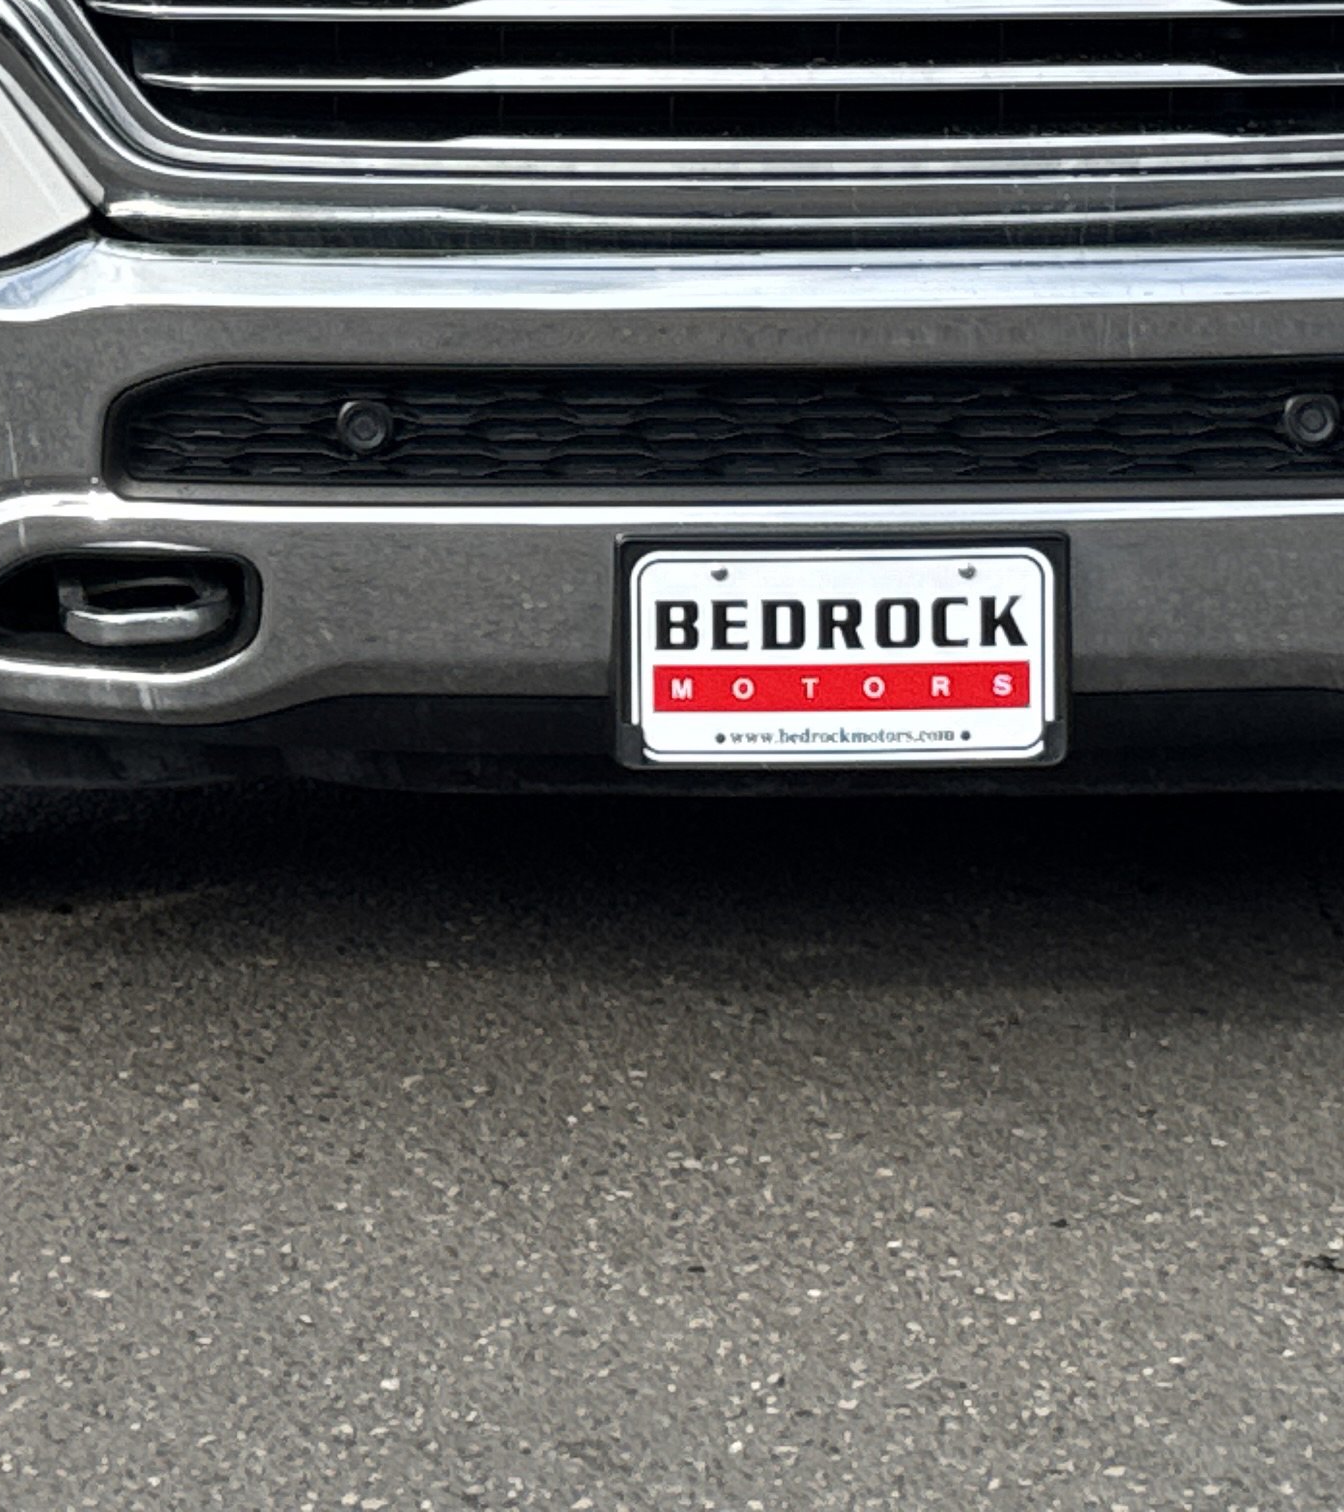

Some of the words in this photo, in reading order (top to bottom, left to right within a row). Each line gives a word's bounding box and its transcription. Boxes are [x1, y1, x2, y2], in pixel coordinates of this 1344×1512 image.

[654, 595, 1028, 651] BEDROCK
[670, 674, 1014, 700] MOTORS
[729, 727, 955, 744] www.bedrockmotors.com
